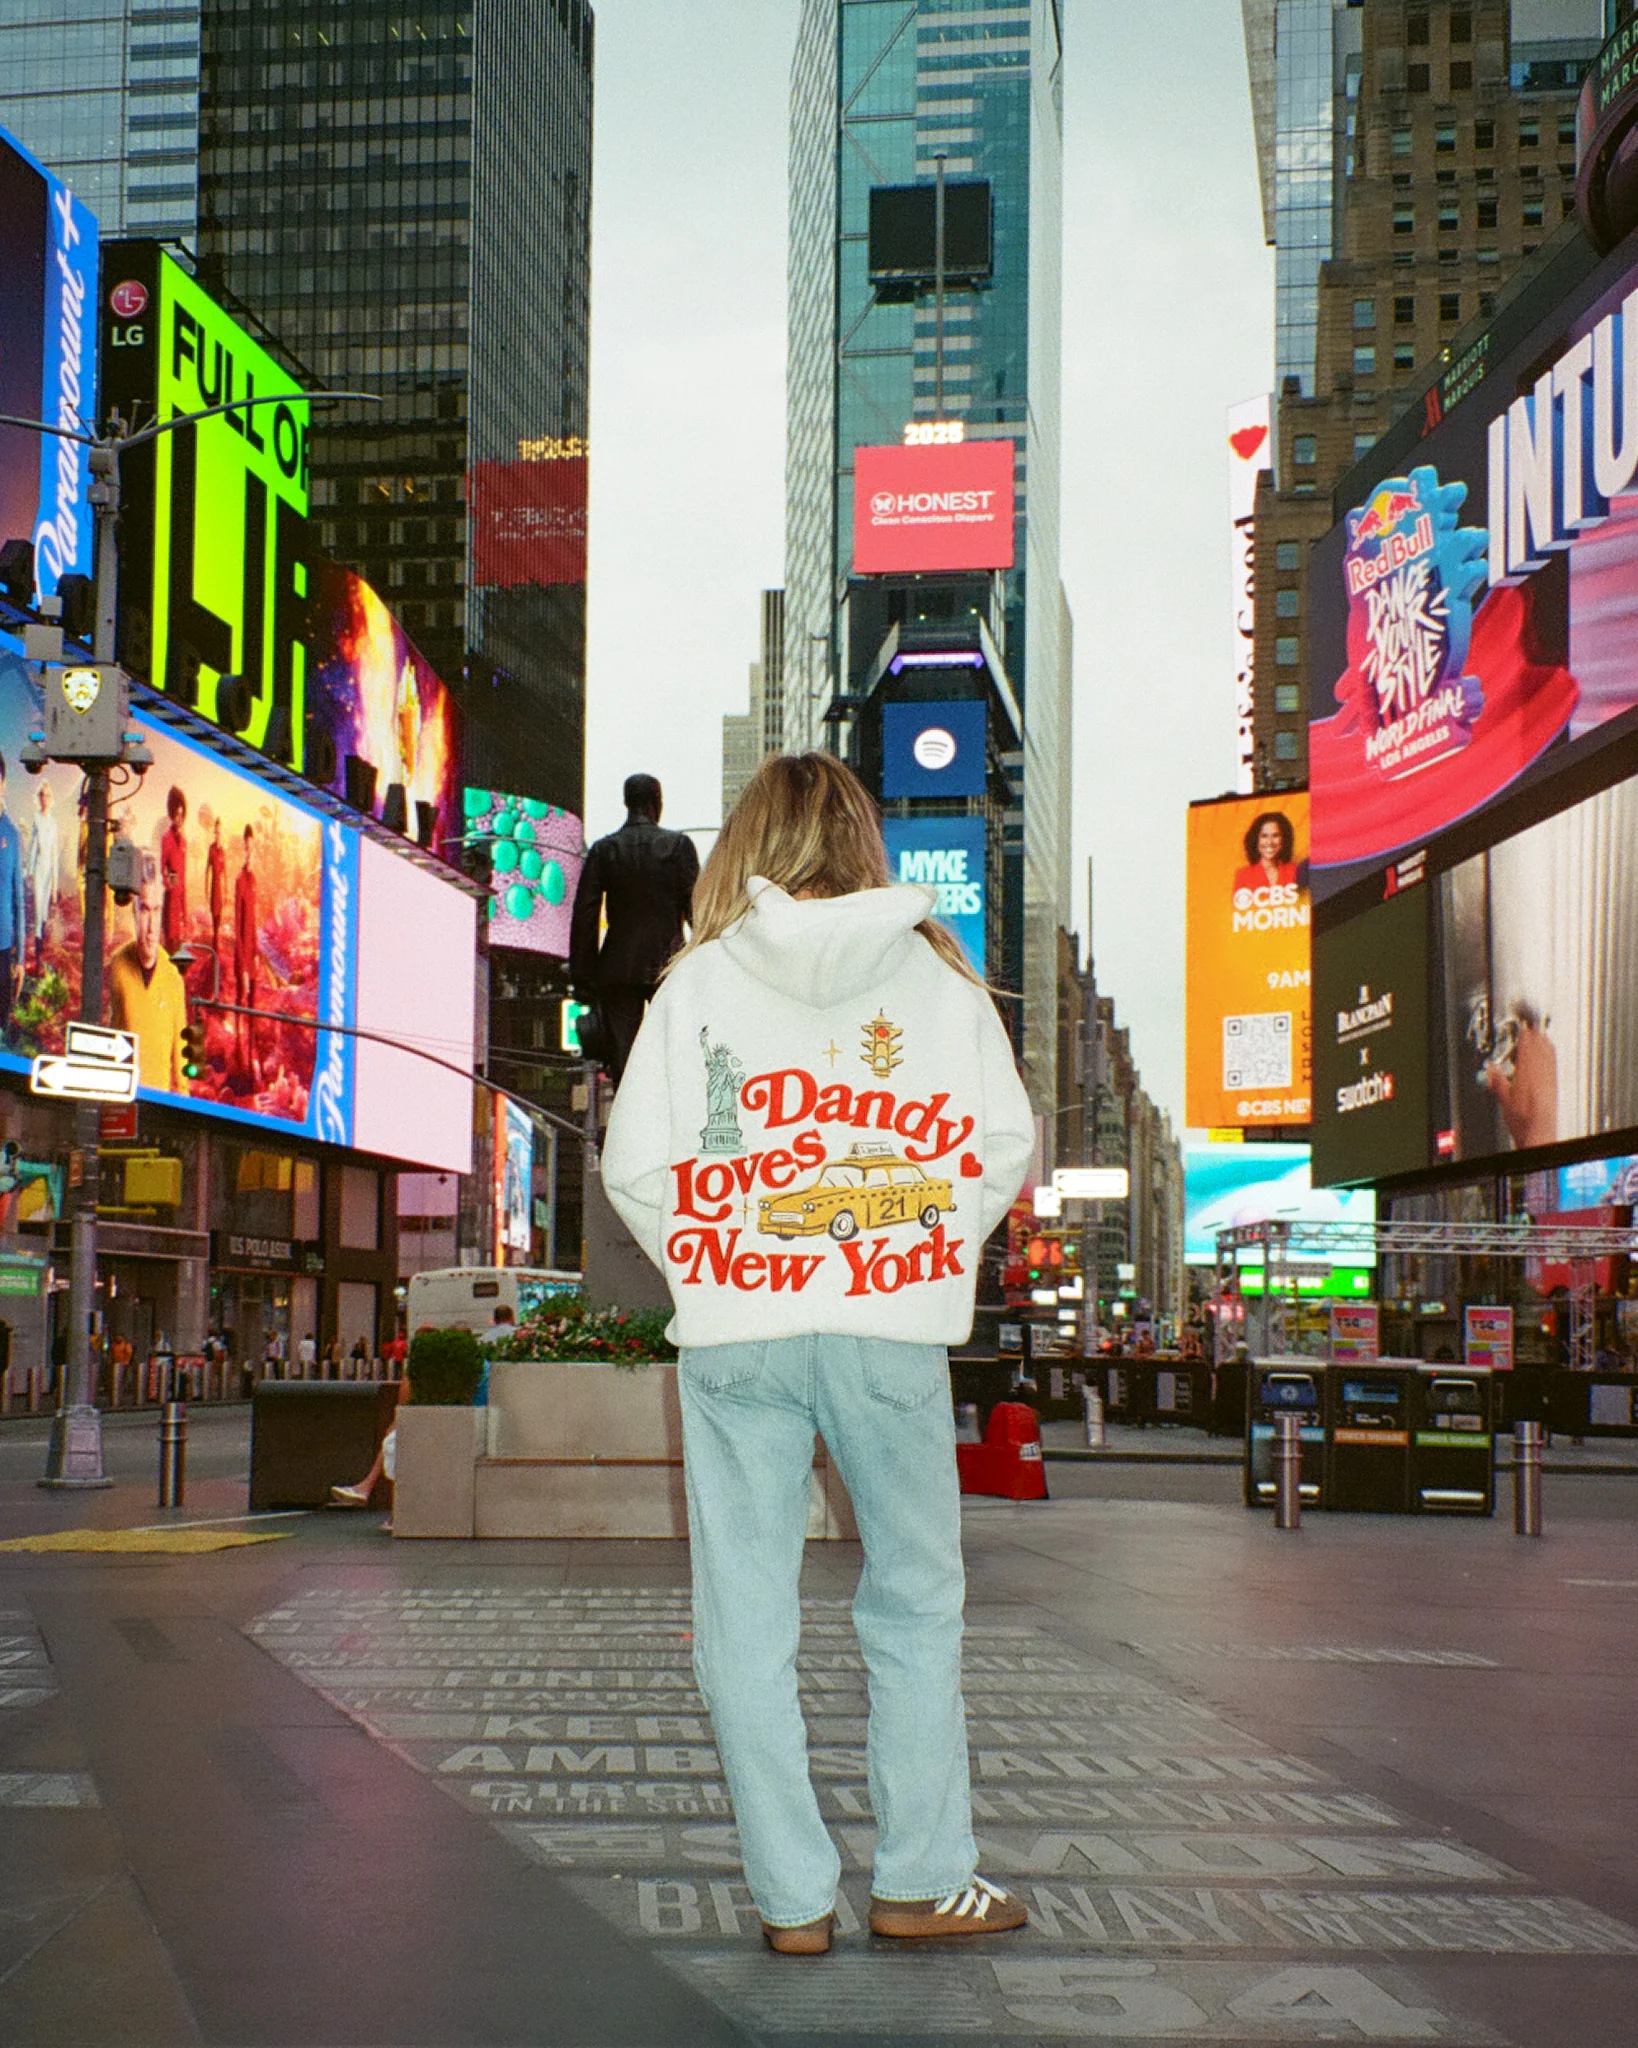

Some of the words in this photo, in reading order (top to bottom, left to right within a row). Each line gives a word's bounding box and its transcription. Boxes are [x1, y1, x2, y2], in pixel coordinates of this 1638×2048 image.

[111, 325, 145, 347] LG
[172, 298, 264, 452] FULL
[904, 420, 965, 446] 2025
[897, 490, 995, 513] HONEST
[871, 516, 900, 526] Clean
[1347, 539, 1392, 596] Red
[1389, 513, 1435, 571] Bull
[1376, 629, 1443, 715] STYLE
[1366, 711, 1418, 762] WORLD
[1417, 685, 1466, 732] FINAL
[1379, 751, 1402, 770] LOS
[1402, 724, 1450, 761] ANGELES
[900, 849, 969, 883] MYKE
[1252, 882, 1299, 909] CBS
[1266, 968, 1311, 990] 9AM
[740, 1068, 975, 1162] Dandy
[1251, 1098, 1282, 1117] CBS
[670, 1128, 827, 1223] Loves
[879, 1195, 906, 1221] 21
[666, 1227, 827, 1293] New
[838, 1223, 965, 1297] York
[482, 1714, 712, 1740] KER
[991, 1957, 1458, 2041] 54
